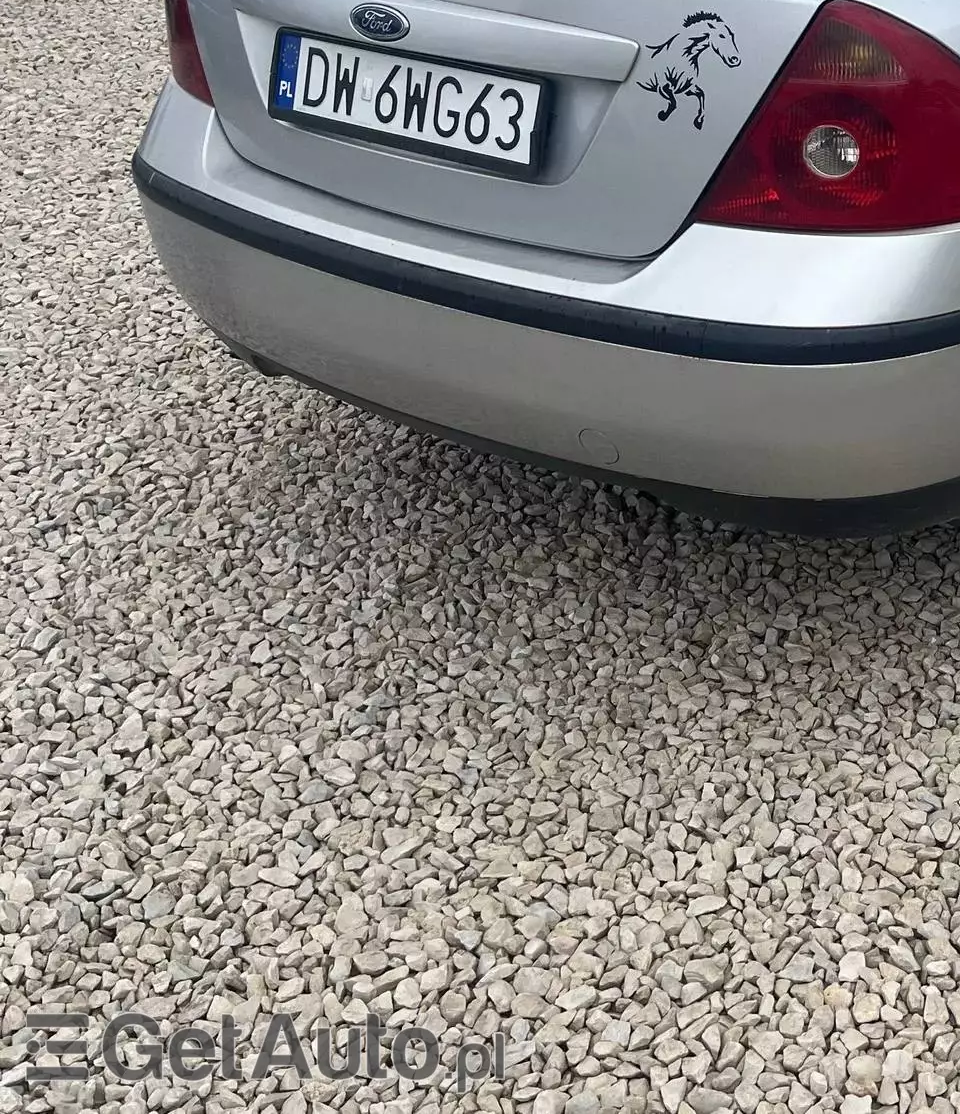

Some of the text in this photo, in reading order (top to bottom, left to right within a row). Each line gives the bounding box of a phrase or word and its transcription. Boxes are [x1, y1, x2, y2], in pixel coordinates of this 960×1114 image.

[361, 10, 394, 32] Ford
[278, 80, 293, 99] PL
[302, 46, 525, 151] DW 6WG63
